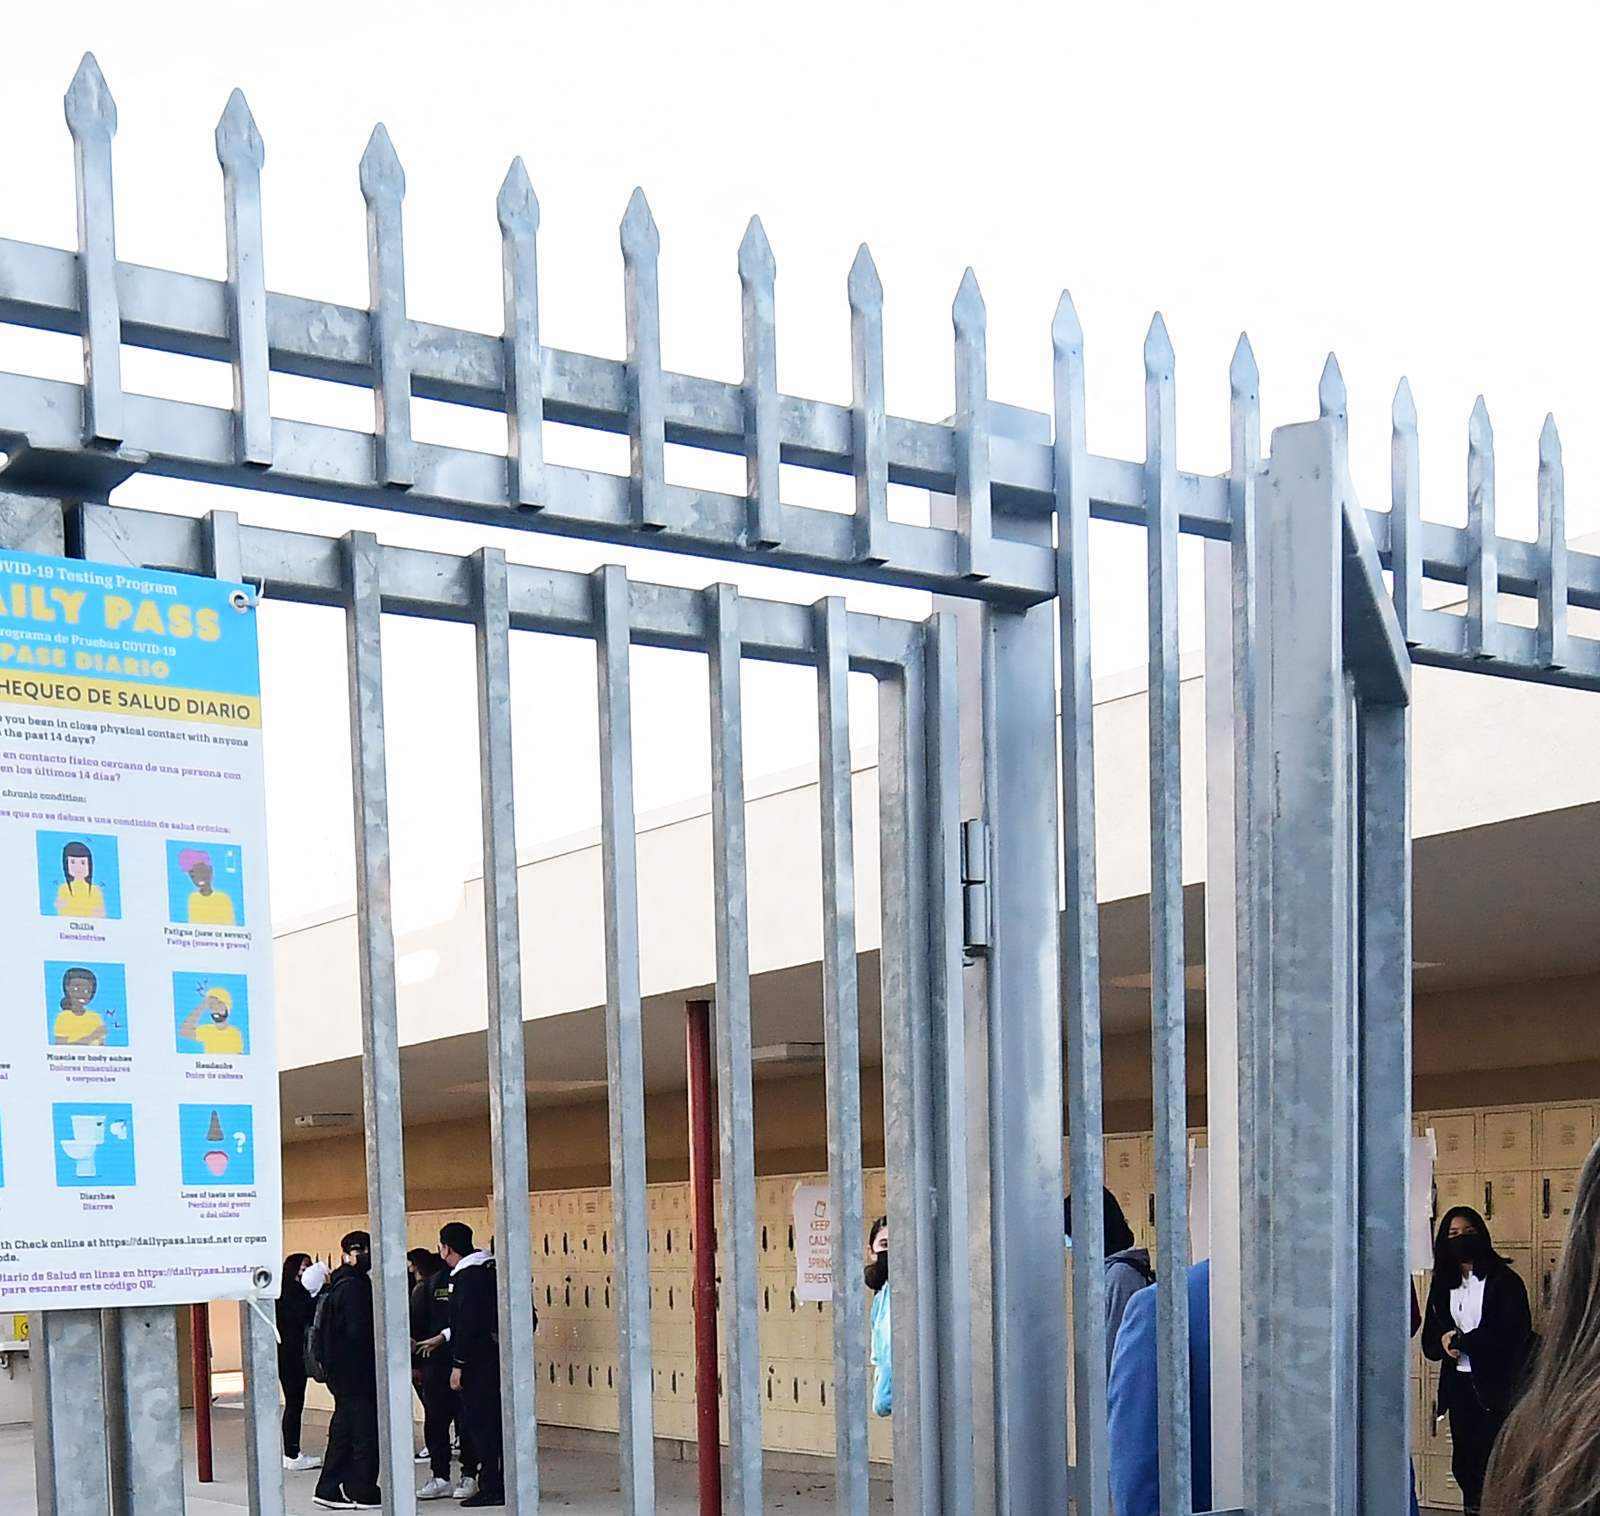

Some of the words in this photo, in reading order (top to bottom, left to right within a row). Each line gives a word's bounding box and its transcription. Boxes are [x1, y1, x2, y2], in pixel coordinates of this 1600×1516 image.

[56, 567, 113, 589] Testing
[115, 574, 176, 595] Program
[104, 595, 220, 640] PASS
[53, 632, 68, 643] de
[71, 634, 120, 649] Pruebas
[122, 640, 176, 656] COVID-19
[0, 643, 65, 665] PASE
[75, 651, 169, 677] DIARIO
[87, 688, 111, 705] DE
[117, 691, 180, 711] SALUD
[186, 699, 250, 719] DIARIO
[4, 715, 25, 724] you
[27, 715, 54, 726] been
[56, 718, 67, 728] in
[69, 720, 97, 731] close
[100, 723, 144, 736] physical
[147, 729, 185, 740] contact
[187, 733, 210, 742] with
[212, 736, 248, 746] anyone
